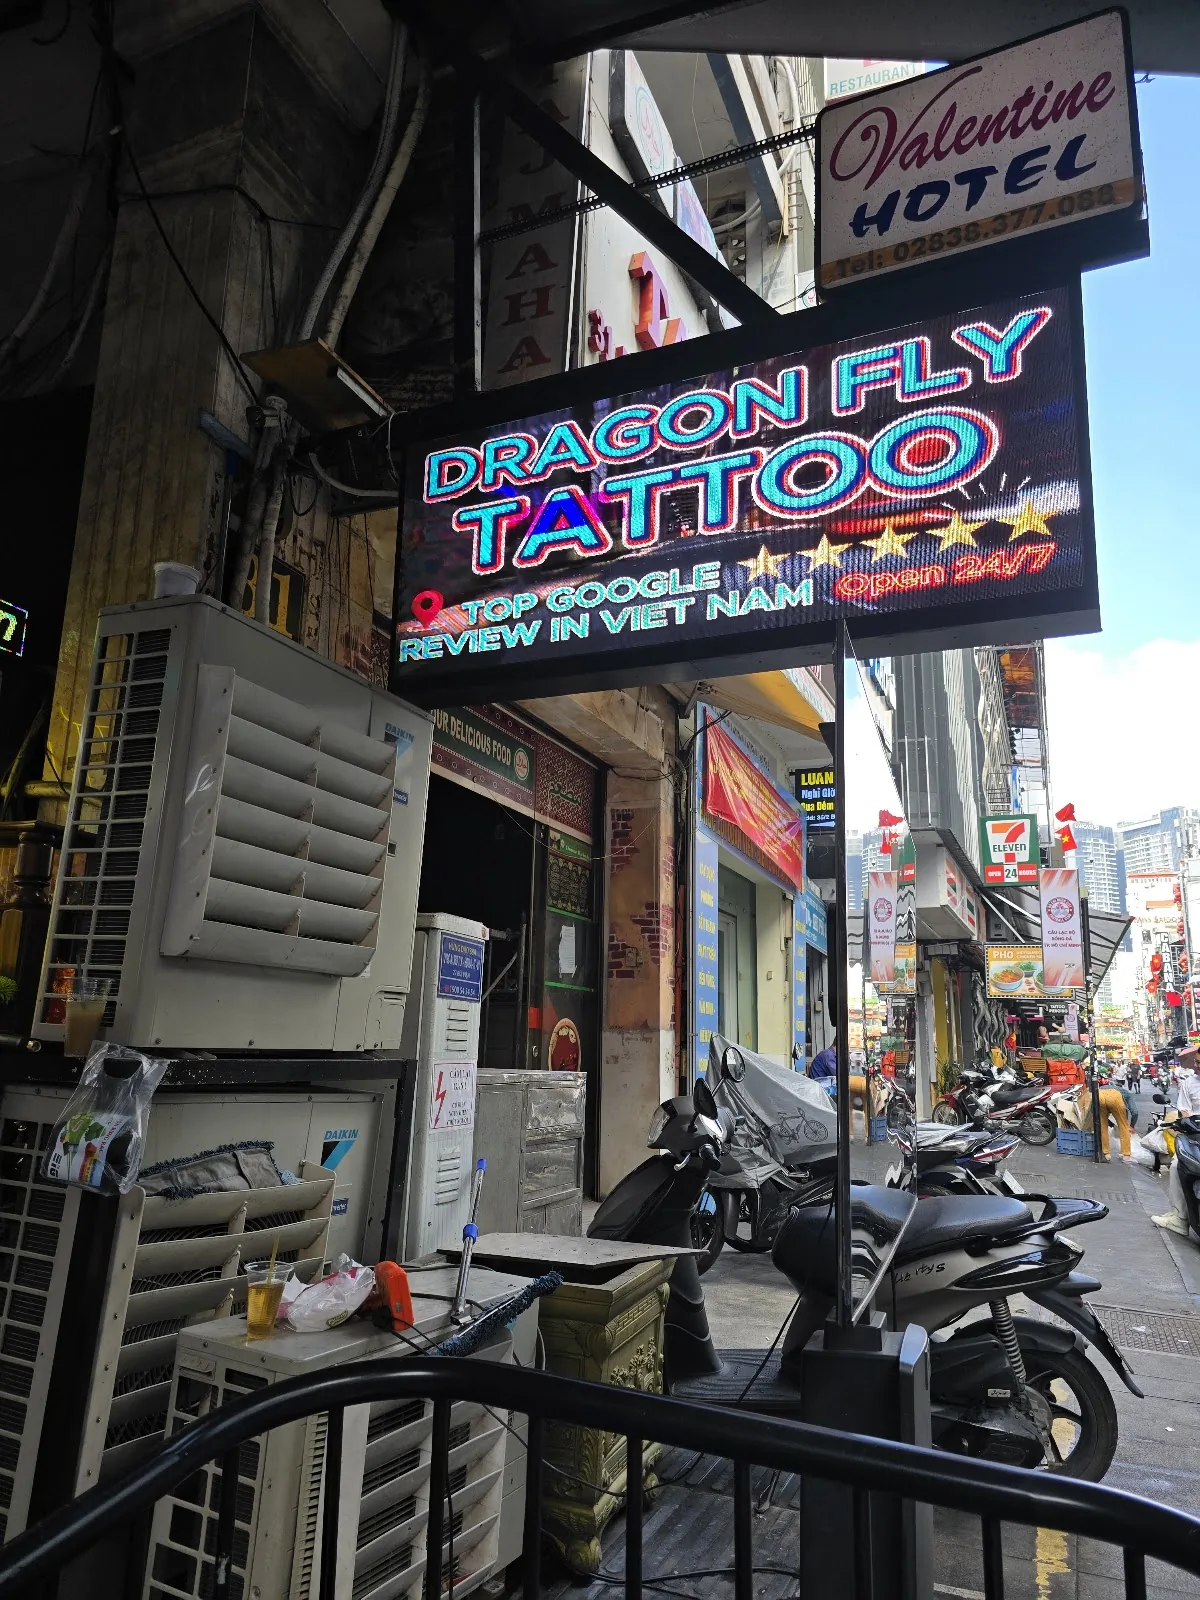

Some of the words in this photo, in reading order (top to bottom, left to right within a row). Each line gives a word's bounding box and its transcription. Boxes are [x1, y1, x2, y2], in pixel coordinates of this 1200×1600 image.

[829, 63, 917, 96] RESTAURANT
[829, 65, 1116, 191] Valentine
[849, 133, 1098, 238] HOTEL
[835, 251, 884, 280] Tel:
[424, 366, 808, 503] DRAGON
[832, 306, 1052, 417] FLY
[452, 406, 999, 576] TATTOO
[461, 592, 539, 626] TOP
[546, 561, 722, 614] GOOGLE
[835, 563, 946, 598] Open
[954, 542, 1058, 582] 24/7
[399, 620, 542, 663] REVIEW
[550, 613, 591, 643] IN
[600, 598, 696, 634] VIET
[706, 579, 815, 621] NAM
[384, 722, 415, 743] DAIKIN
[450, 715, 491, 756] DELICIOUS
[492, 739, 511, 766] FOOD
[1005, 868, 1017, 878] 24
[1160, 932, 1175, 993] CABANA
[323, 1128, 359, 1142] DAIKIN
